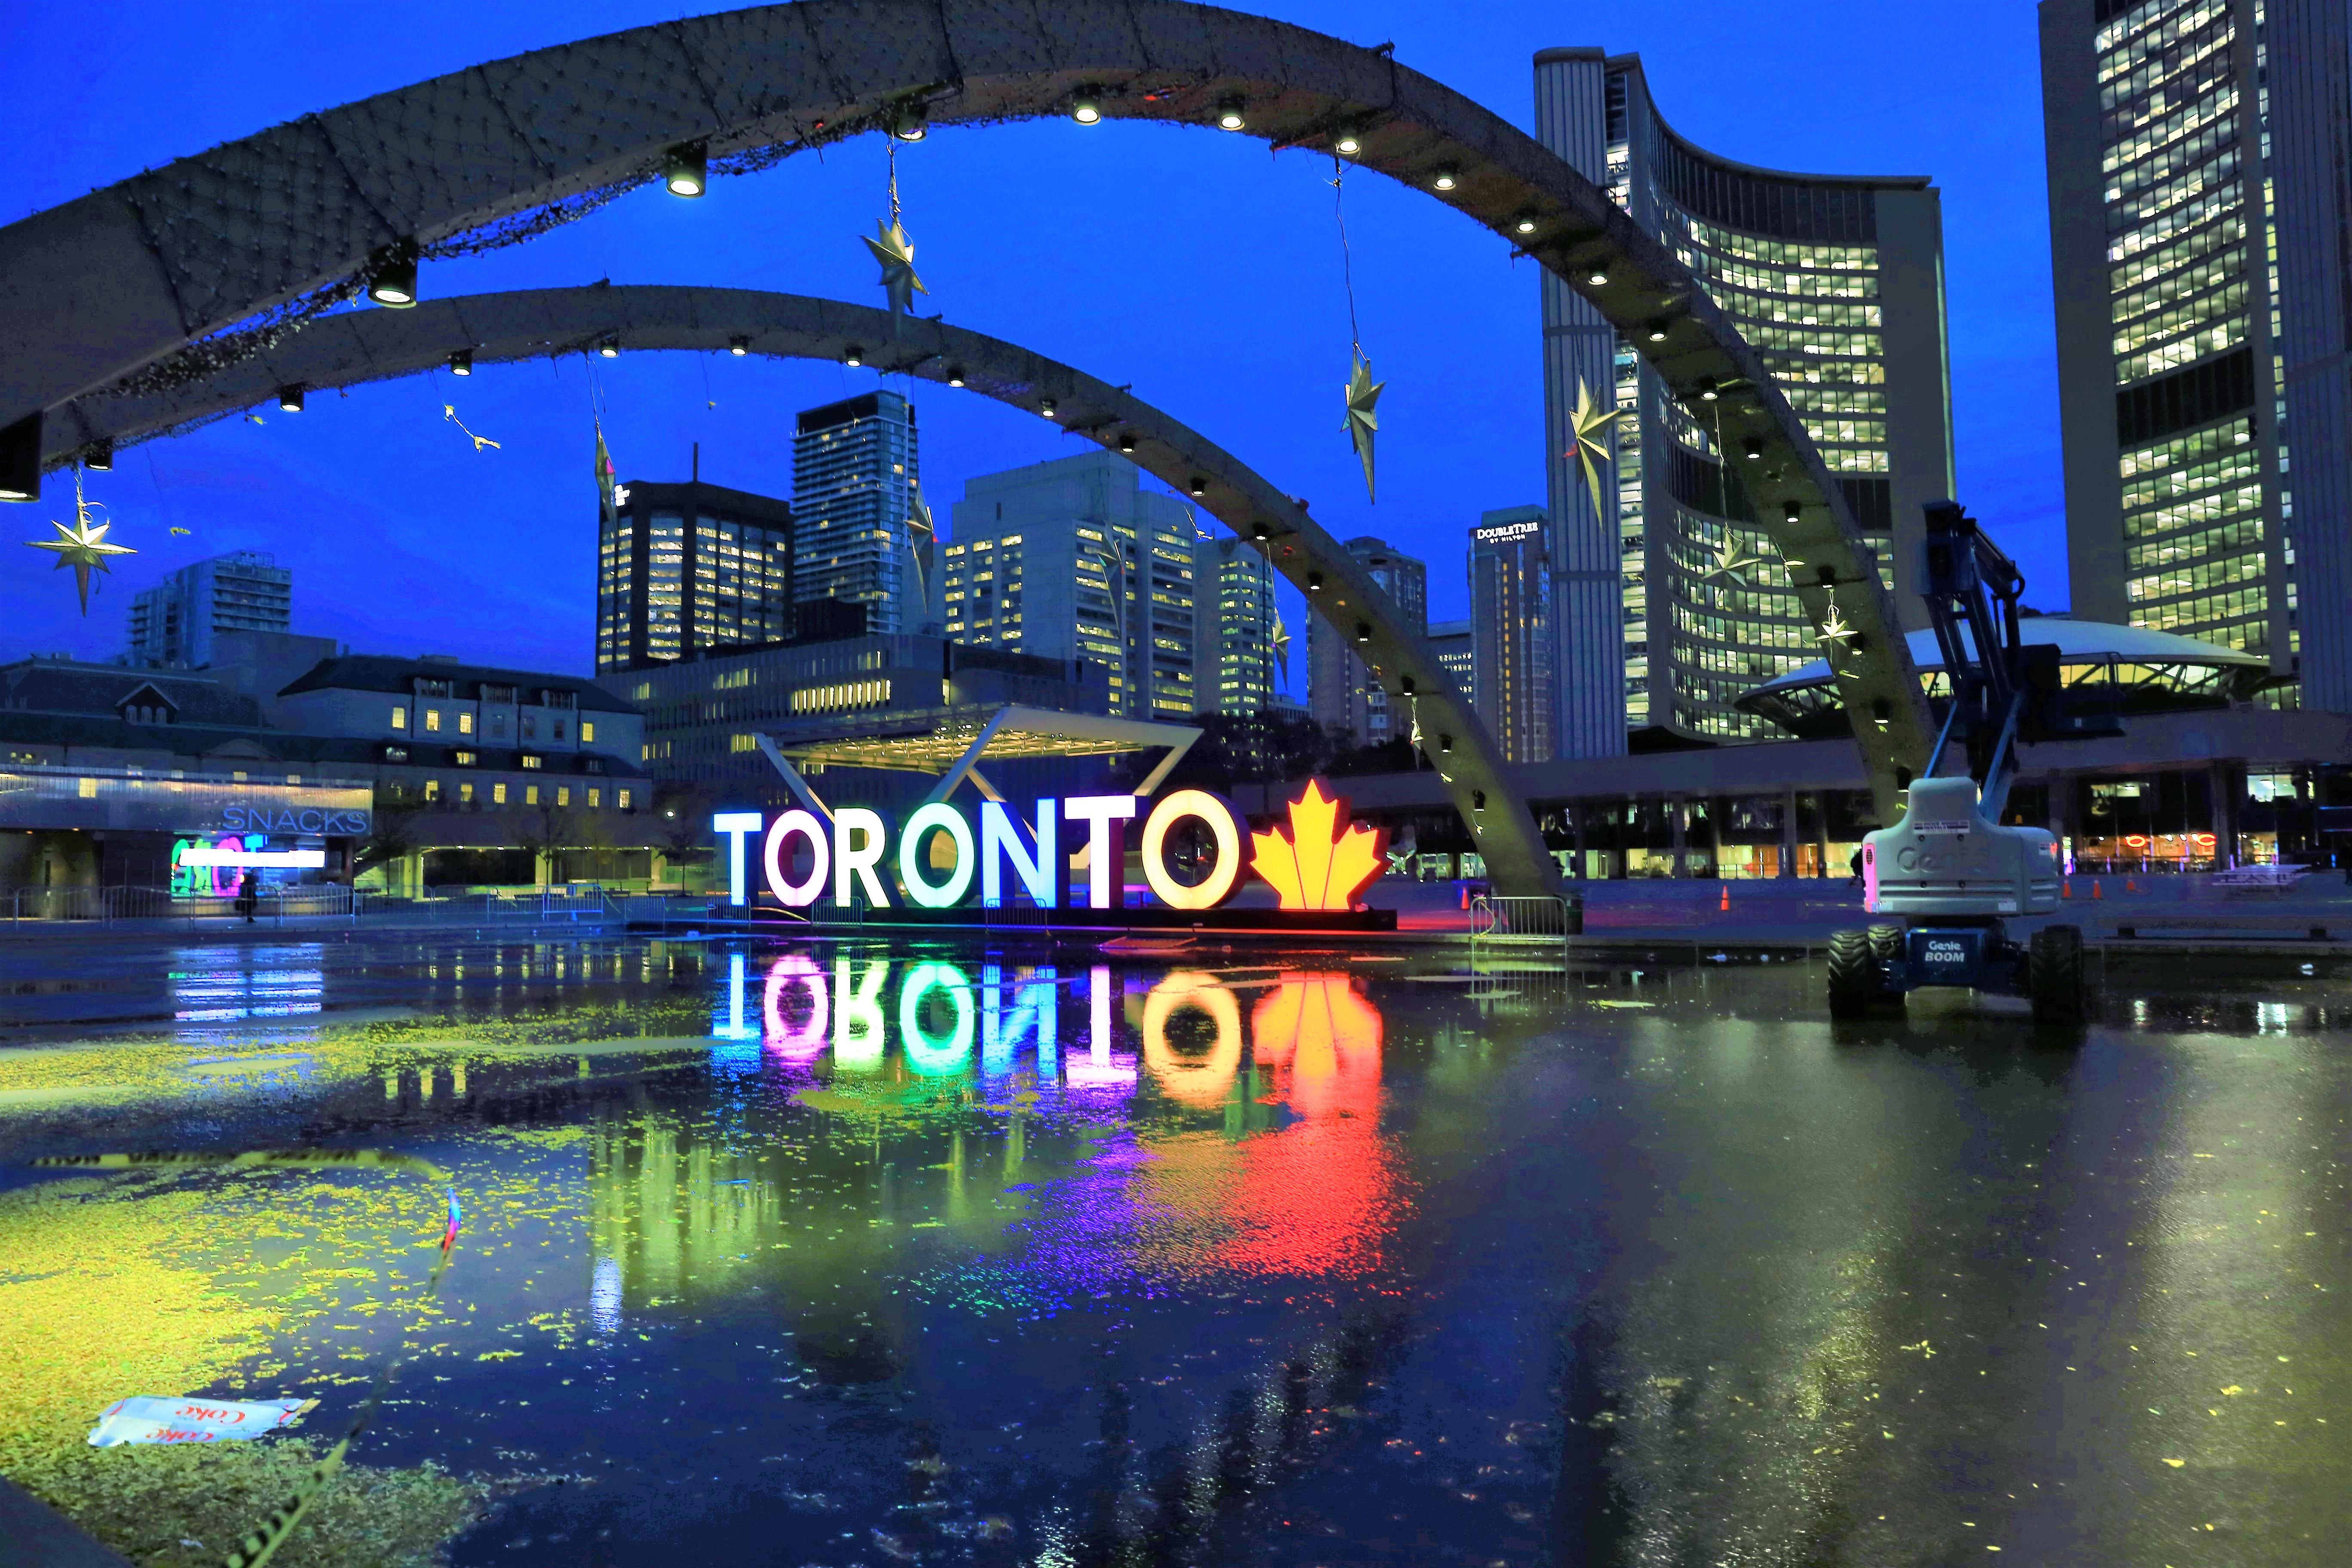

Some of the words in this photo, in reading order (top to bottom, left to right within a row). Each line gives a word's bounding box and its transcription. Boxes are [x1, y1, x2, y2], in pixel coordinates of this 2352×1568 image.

[223, 808, 368, 833] SNACKS
[714, 789, 1240, 910] TORONTO
[1929, 941, 1961, 950] Genie
[1925, 952, 1965, 962] BOOM
[176, 1406, 245, 1424] Coke
